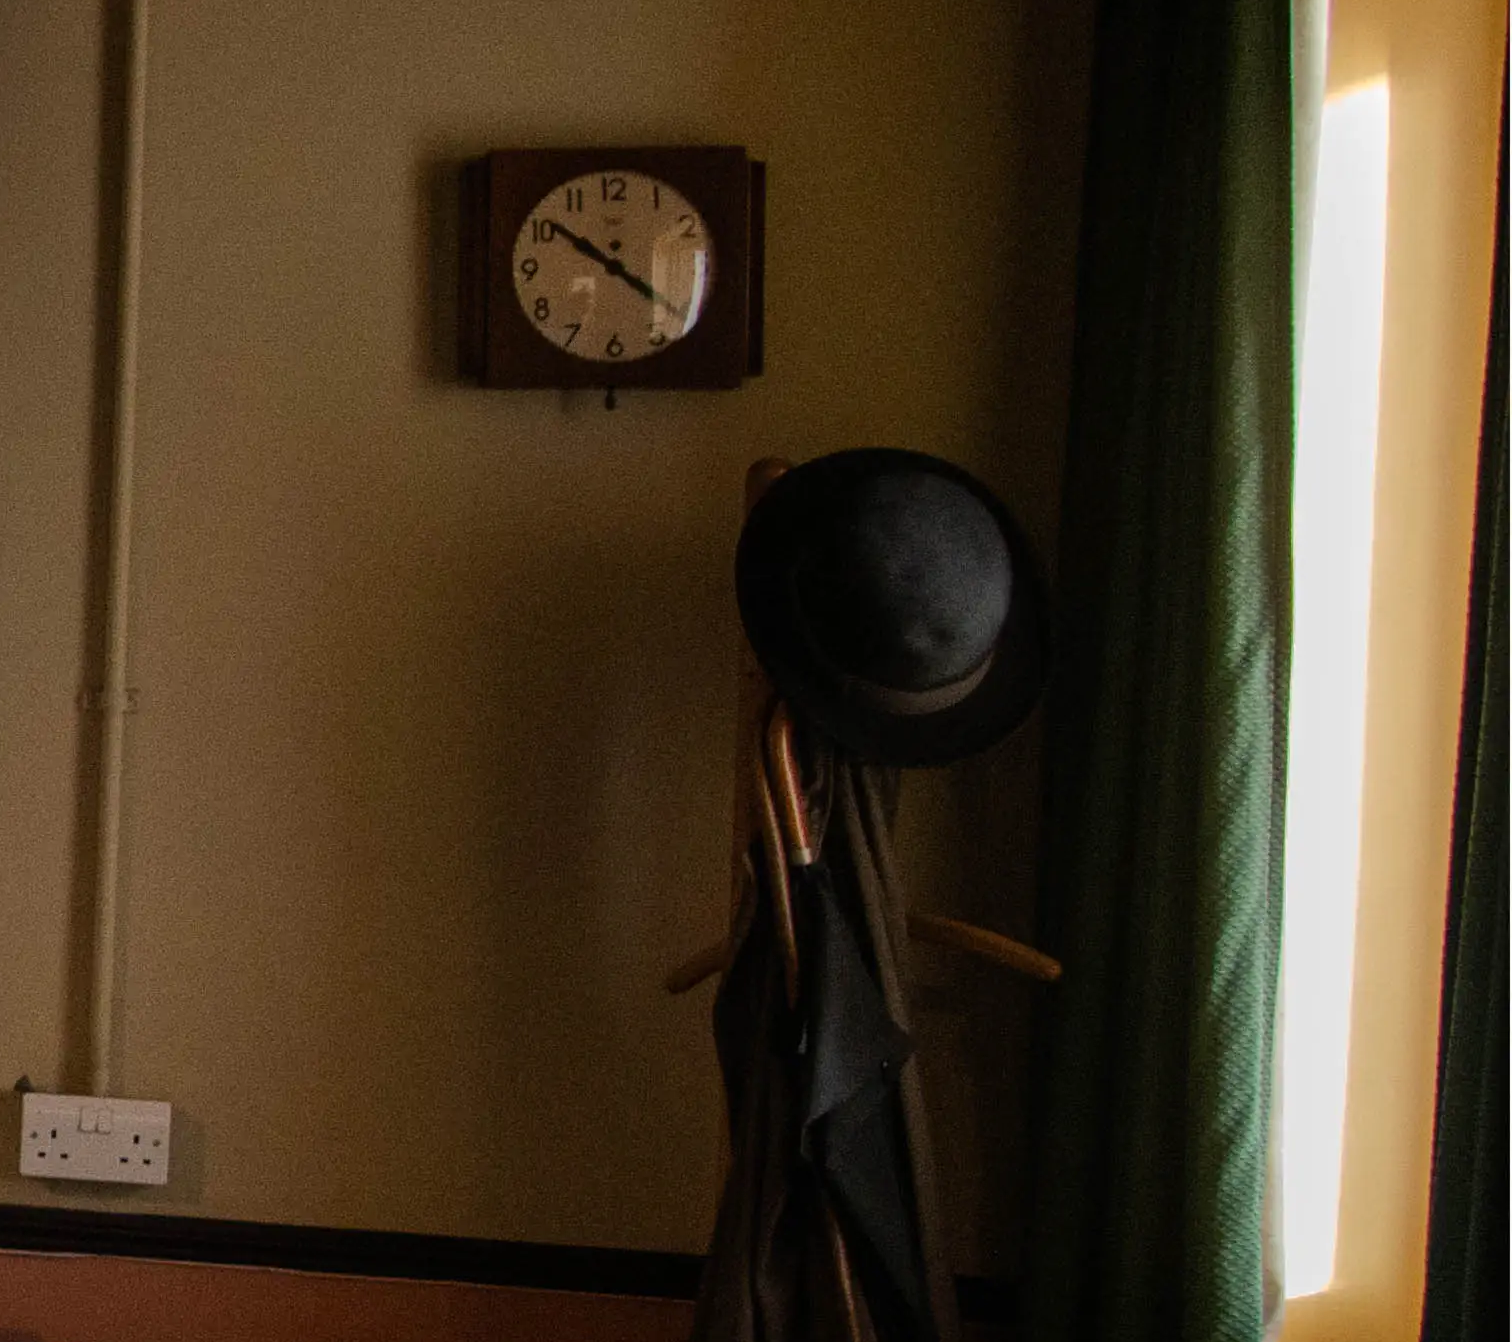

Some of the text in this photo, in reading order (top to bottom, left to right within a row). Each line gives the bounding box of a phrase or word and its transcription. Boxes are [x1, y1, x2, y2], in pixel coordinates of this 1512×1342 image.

[566, 187, 583, 212] 11
[602, 176, 627, 201] 12
[532, 218, 555, 244] 10
[678, 214, 697, 239] 2
[521, 258, 539, 281] 9
[534, 297, 550, 321] 8
[563, 323, 582, 347] 7
[606, 333, 624, 357] 6
